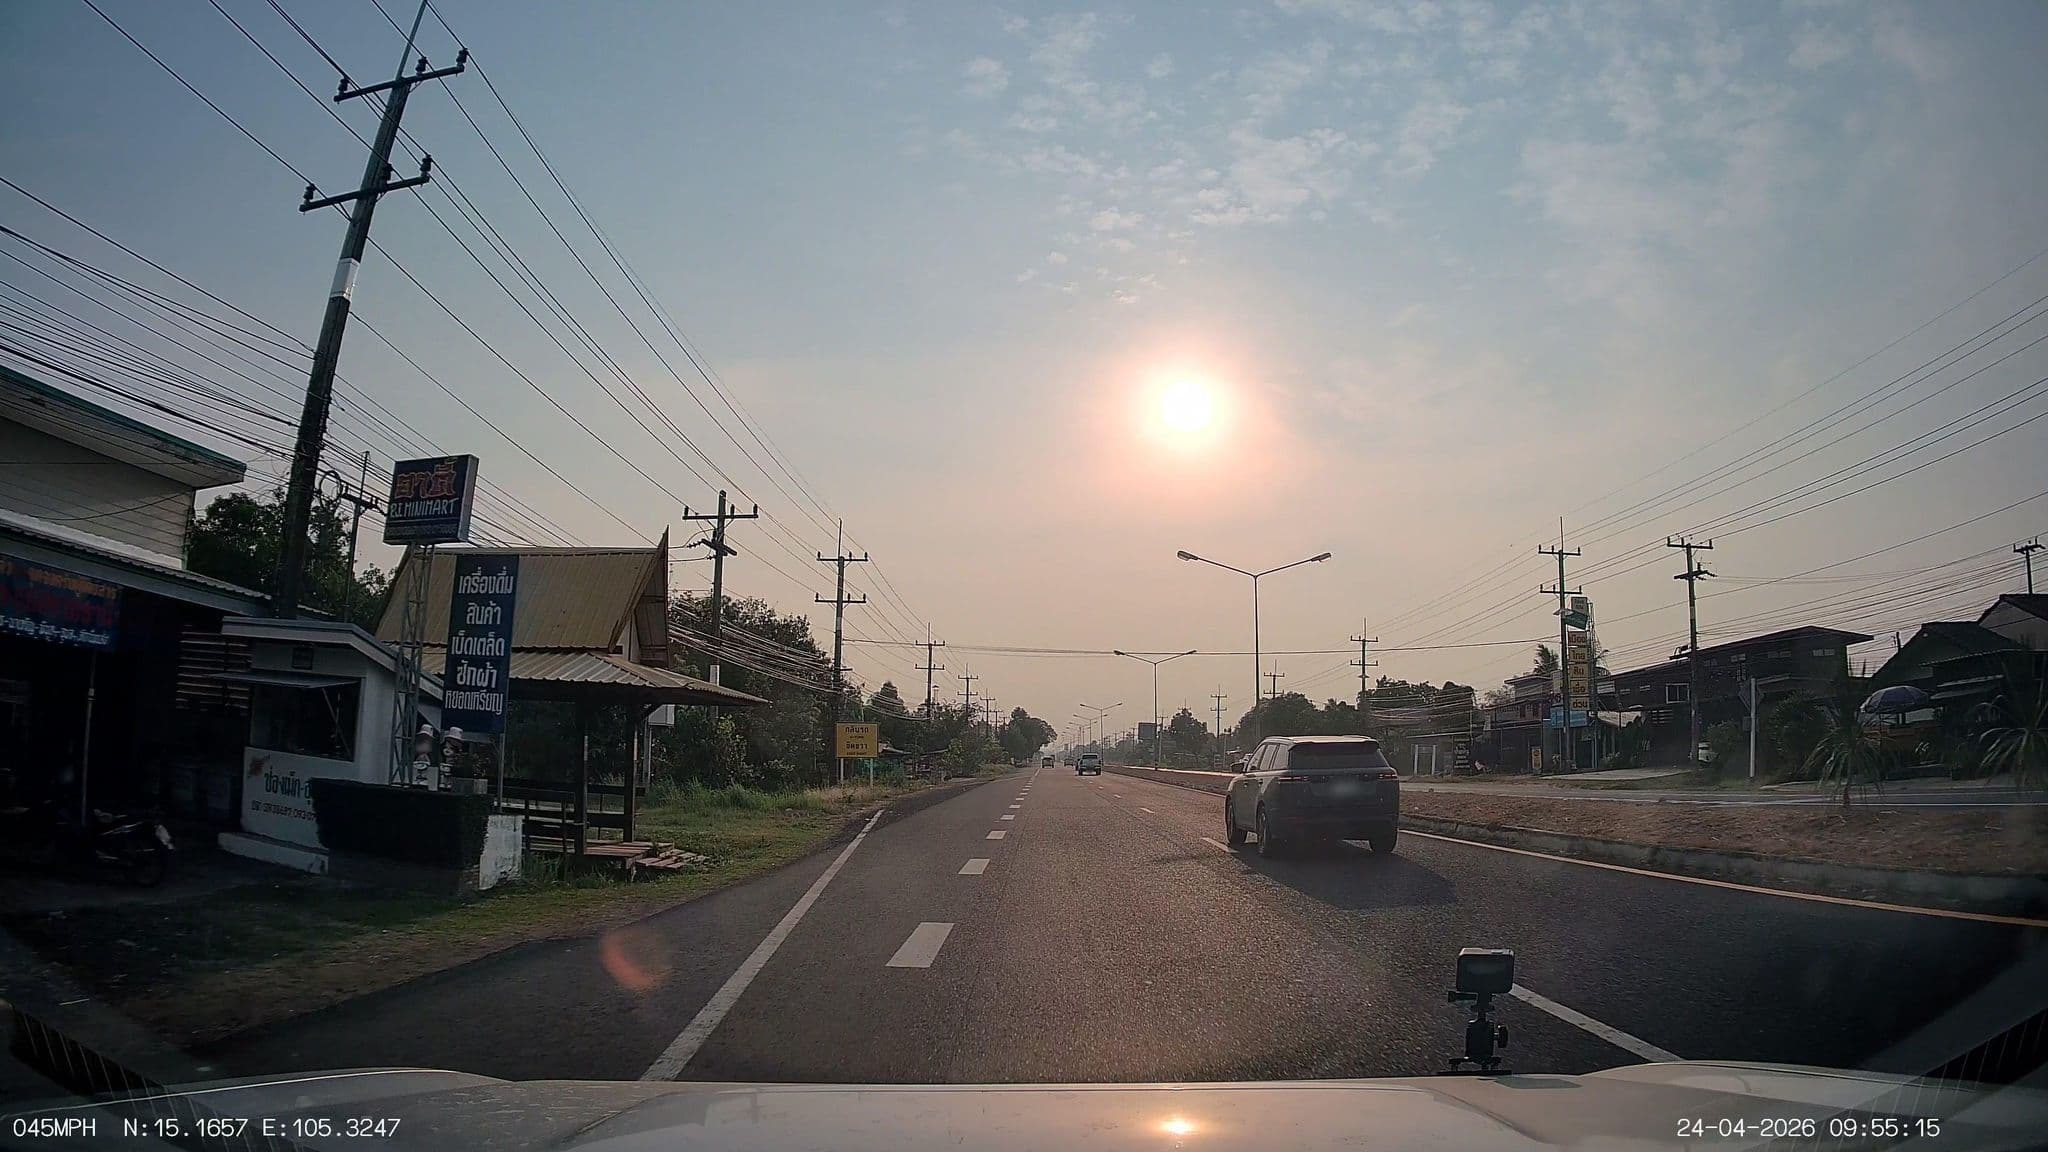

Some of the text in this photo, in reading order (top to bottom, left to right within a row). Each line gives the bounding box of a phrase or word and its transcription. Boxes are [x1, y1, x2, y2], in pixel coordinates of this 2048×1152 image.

[458, 566, 514, 595] เครื่องดื่ม
[466, 602, 502, 625] สินค้า
[451, 631, 505, 657] เบ็ดเตล็ด
[456, 660, 497, 687] ซักผ้า
[445, 691, 504, 716] หยอดเหรียญ
